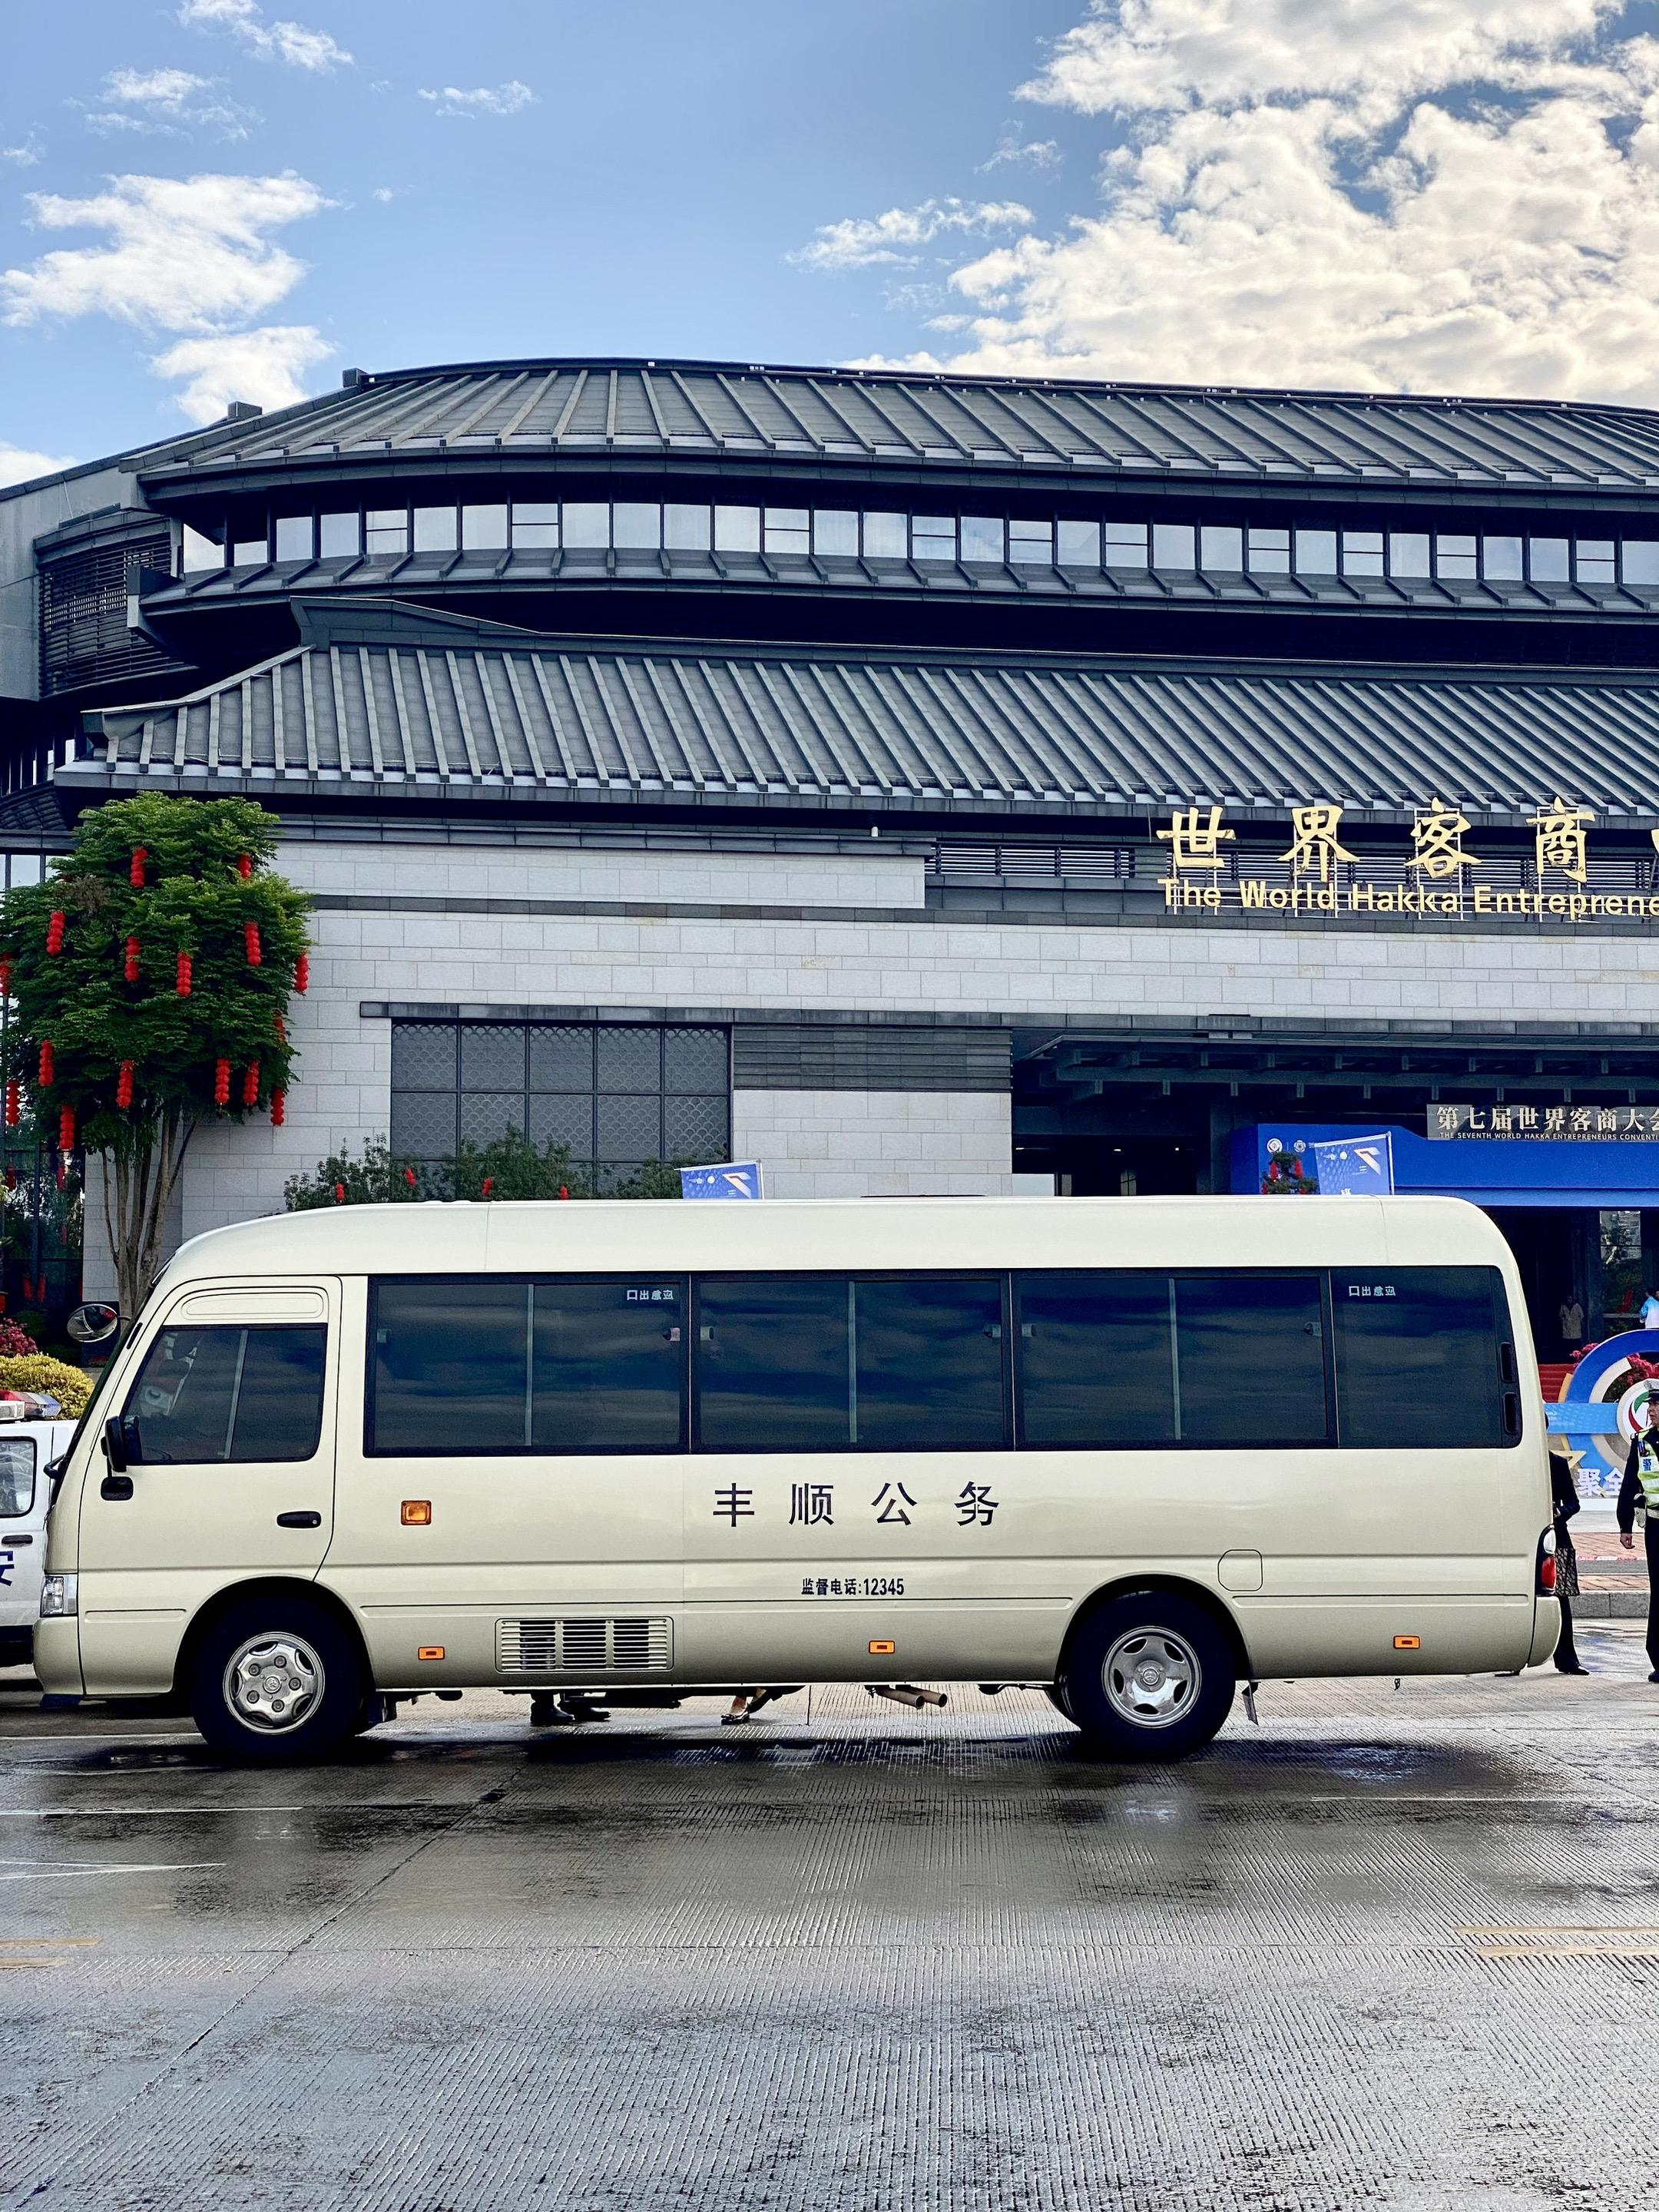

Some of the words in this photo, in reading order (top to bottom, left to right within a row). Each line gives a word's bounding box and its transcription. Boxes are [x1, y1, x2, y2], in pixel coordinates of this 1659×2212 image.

[1156, 796, 1659, 884] 世界客商
[1157, 879, 1221, 907] The
[1240, 880, 1334, 910] World
[1352, 883, 1458, 913] Hakka
[1475, 886, 1659, 921] Entreprene
[713, 1481, 999, 1528] 丰顺公务
[801, 1578, 904, 1596] 监督电话:12345
